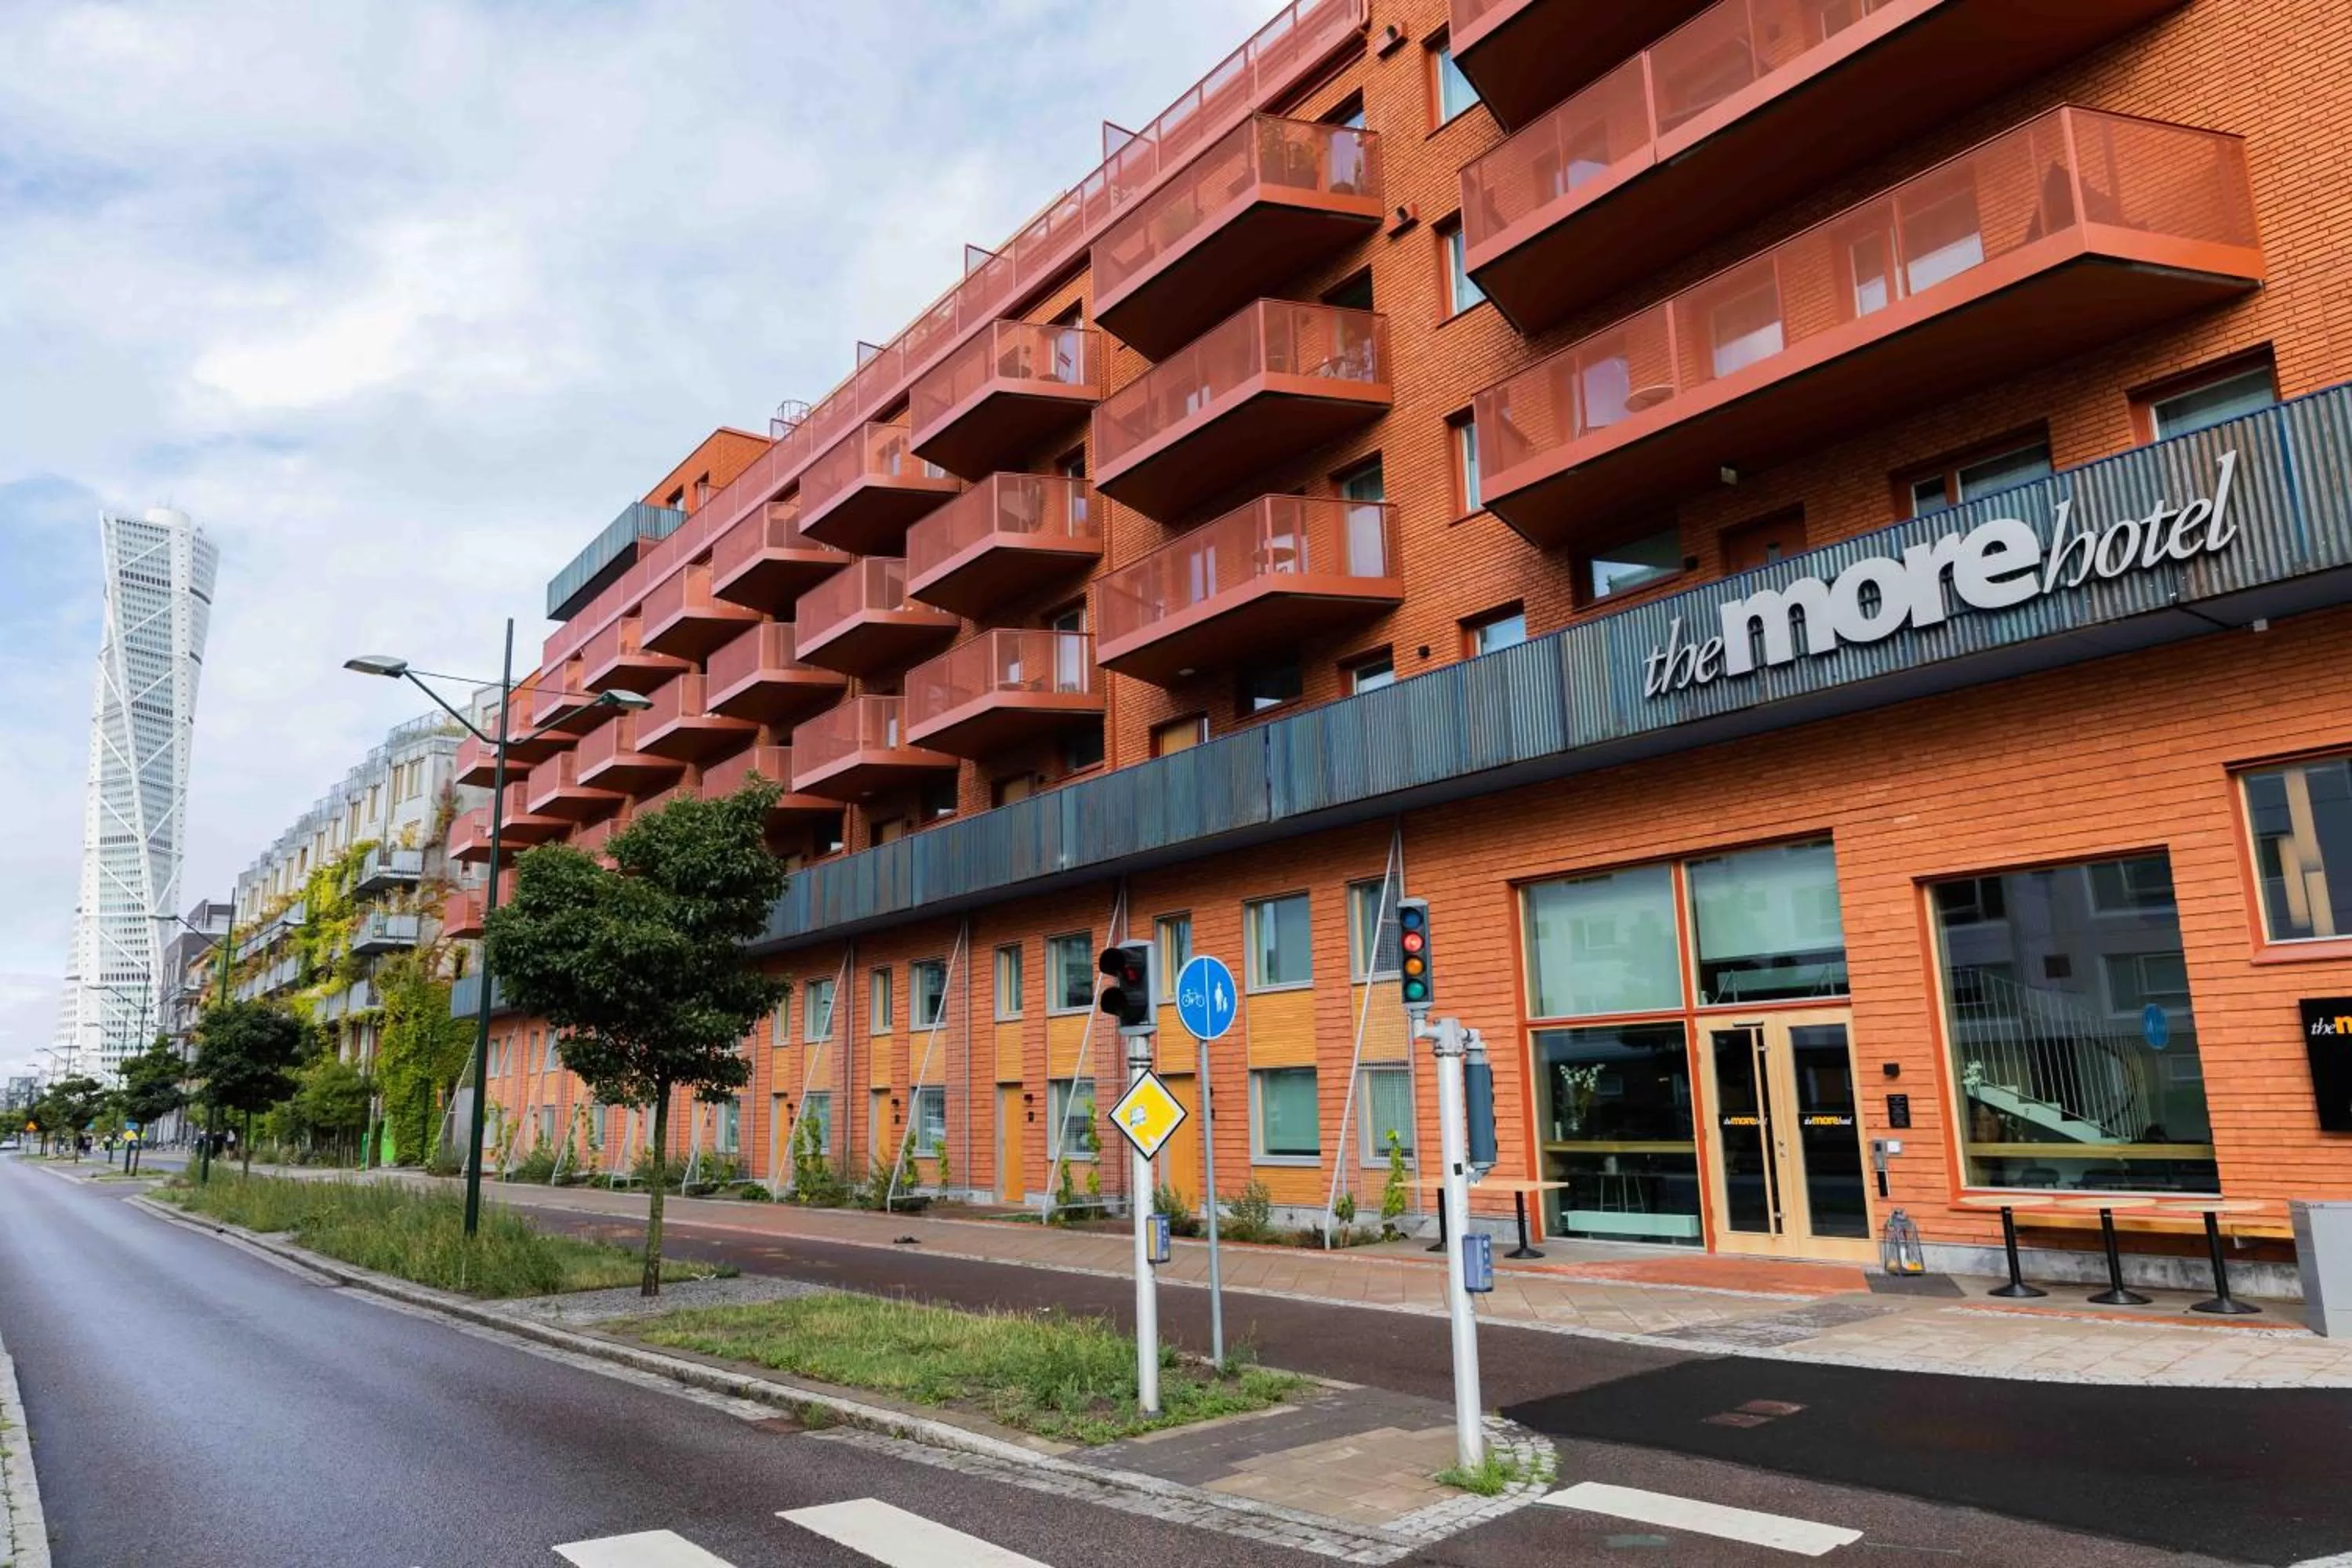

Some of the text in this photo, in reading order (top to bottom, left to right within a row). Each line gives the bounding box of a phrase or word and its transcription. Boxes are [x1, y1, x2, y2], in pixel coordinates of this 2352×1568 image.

[1643, 449, 2237, 698] the more hotel
[2311, 1017, 2336, 1035] the
